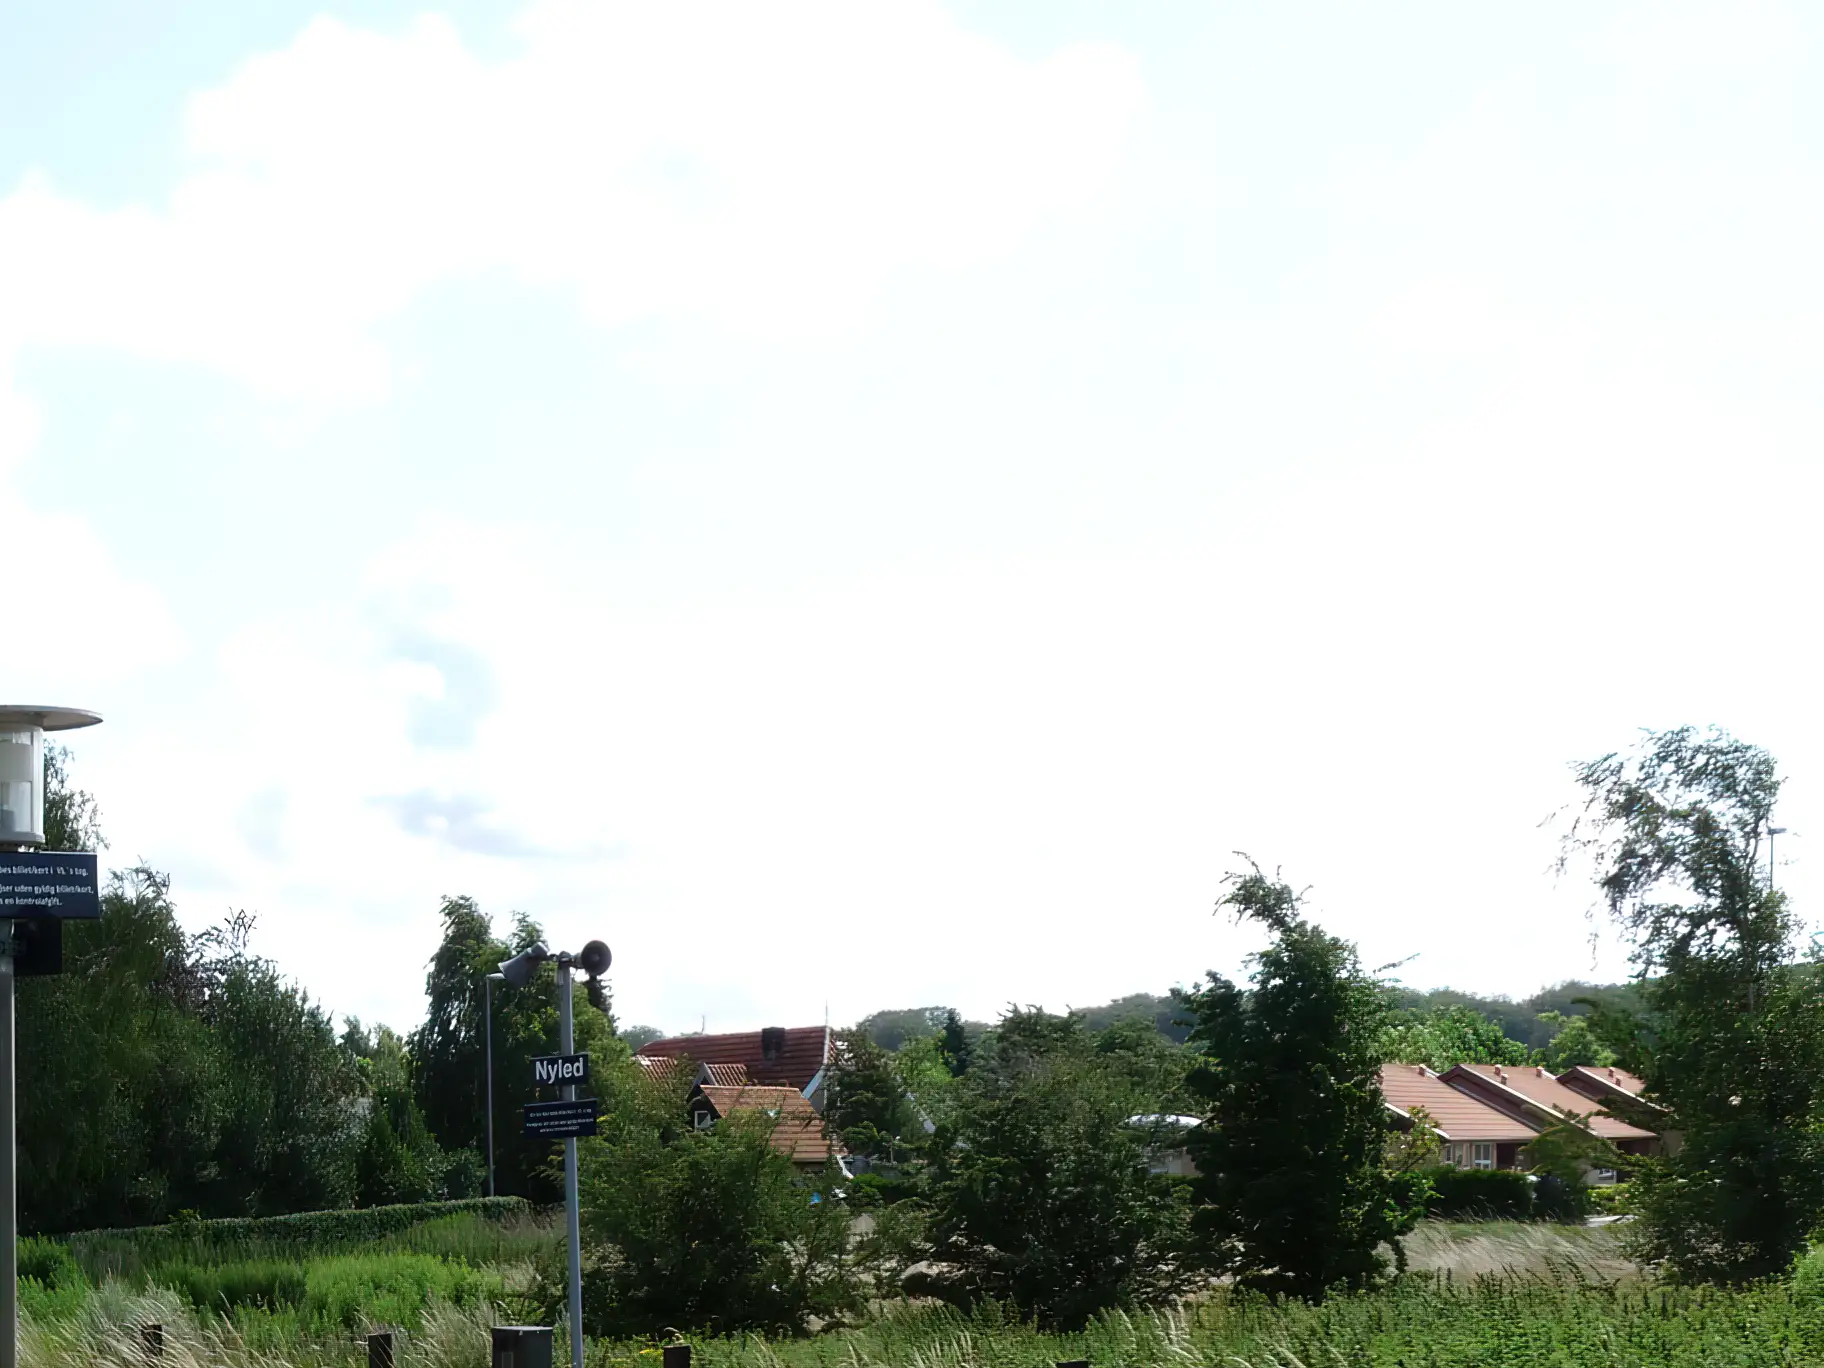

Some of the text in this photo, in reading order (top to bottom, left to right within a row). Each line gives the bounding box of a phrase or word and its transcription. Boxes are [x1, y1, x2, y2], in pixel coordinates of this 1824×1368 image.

[14, 884, 33, 893] uden
[34, 884, 55, 895] gyldig
[4, 898, 15, 906] en
[535, 1057, 584, 1085] Nyled
